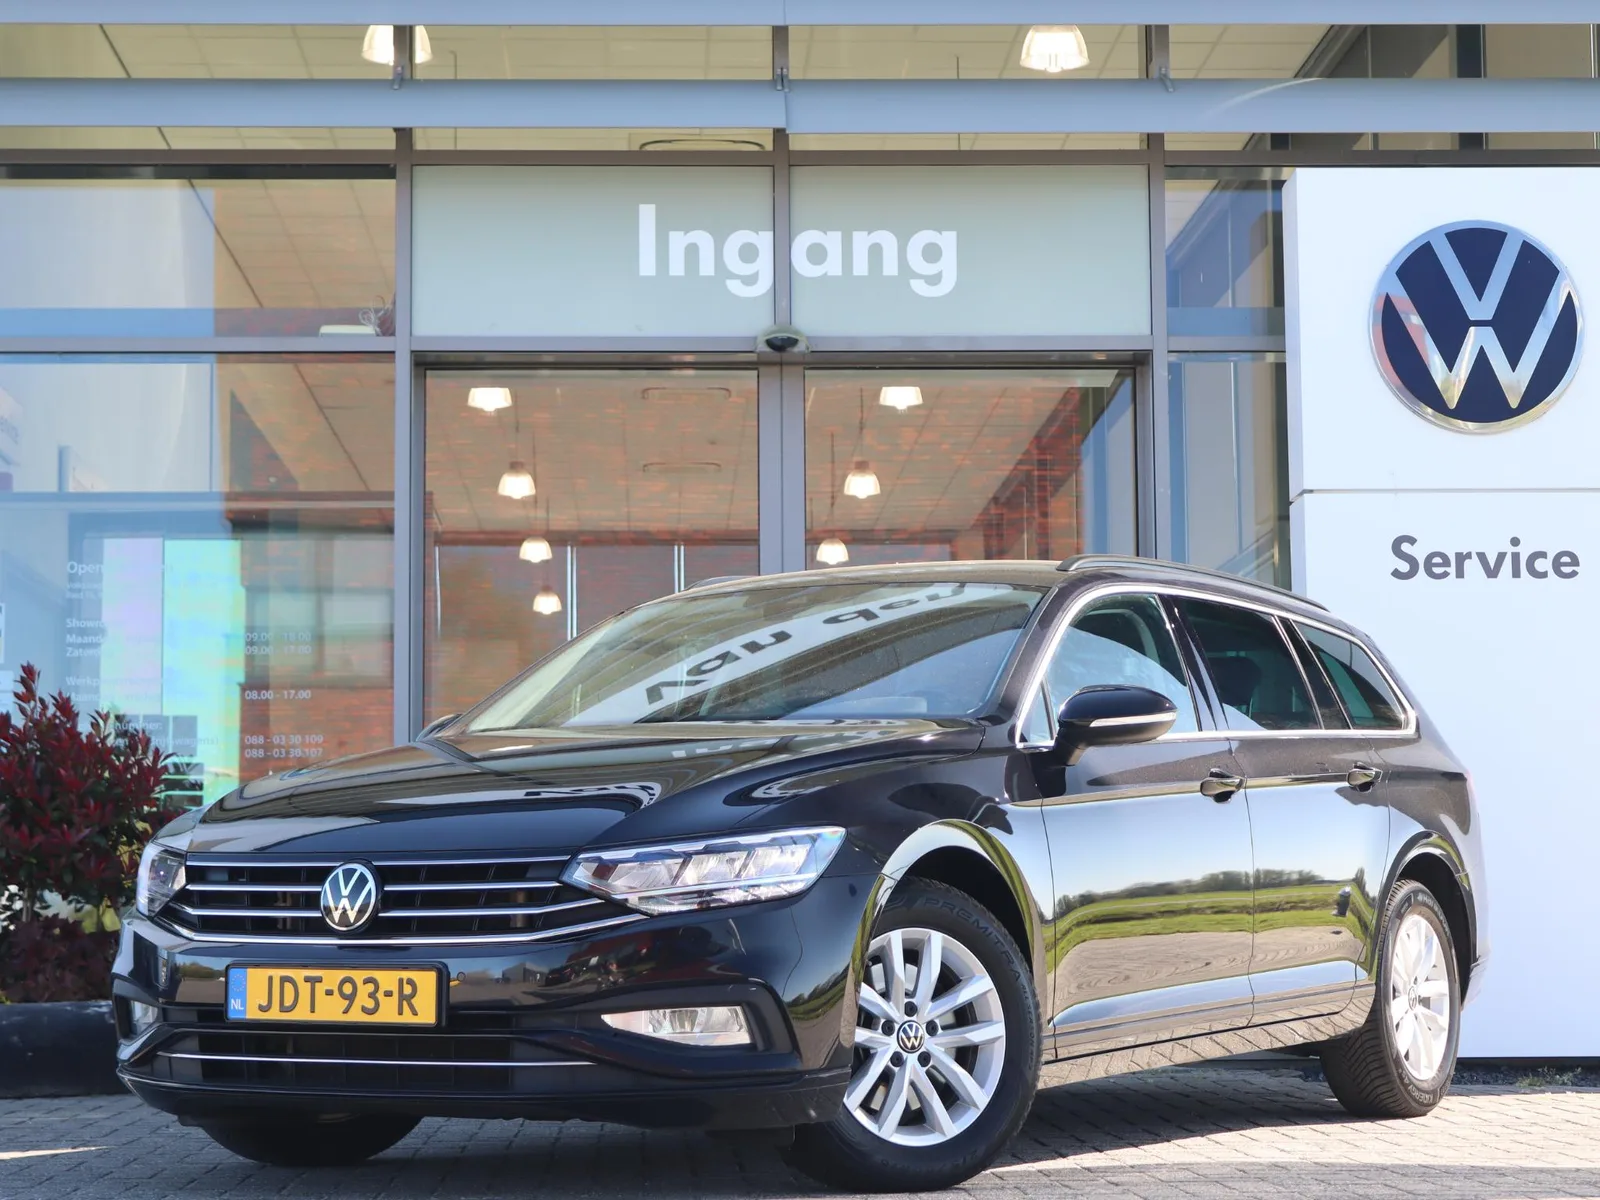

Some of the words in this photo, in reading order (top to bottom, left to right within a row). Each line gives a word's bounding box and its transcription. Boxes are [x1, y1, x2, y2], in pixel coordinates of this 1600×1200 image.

[639, 203, 957, 297] Ingang
[1391, 534, 1580, 580] Service
[245, 690, 273, 700] 08.00
[283, 690, 311, 699] 17.00
[245, 735, 264, 745] 088
[272, 735, 285, 745] 03
[304, 734, 323, 744] 109
[245, 748, 264, 758] 088
[272, 748, 285, 758] 03
[258, 975, 419, 1016] JDT-93-R
[230, 998, 244, 1010] NL
